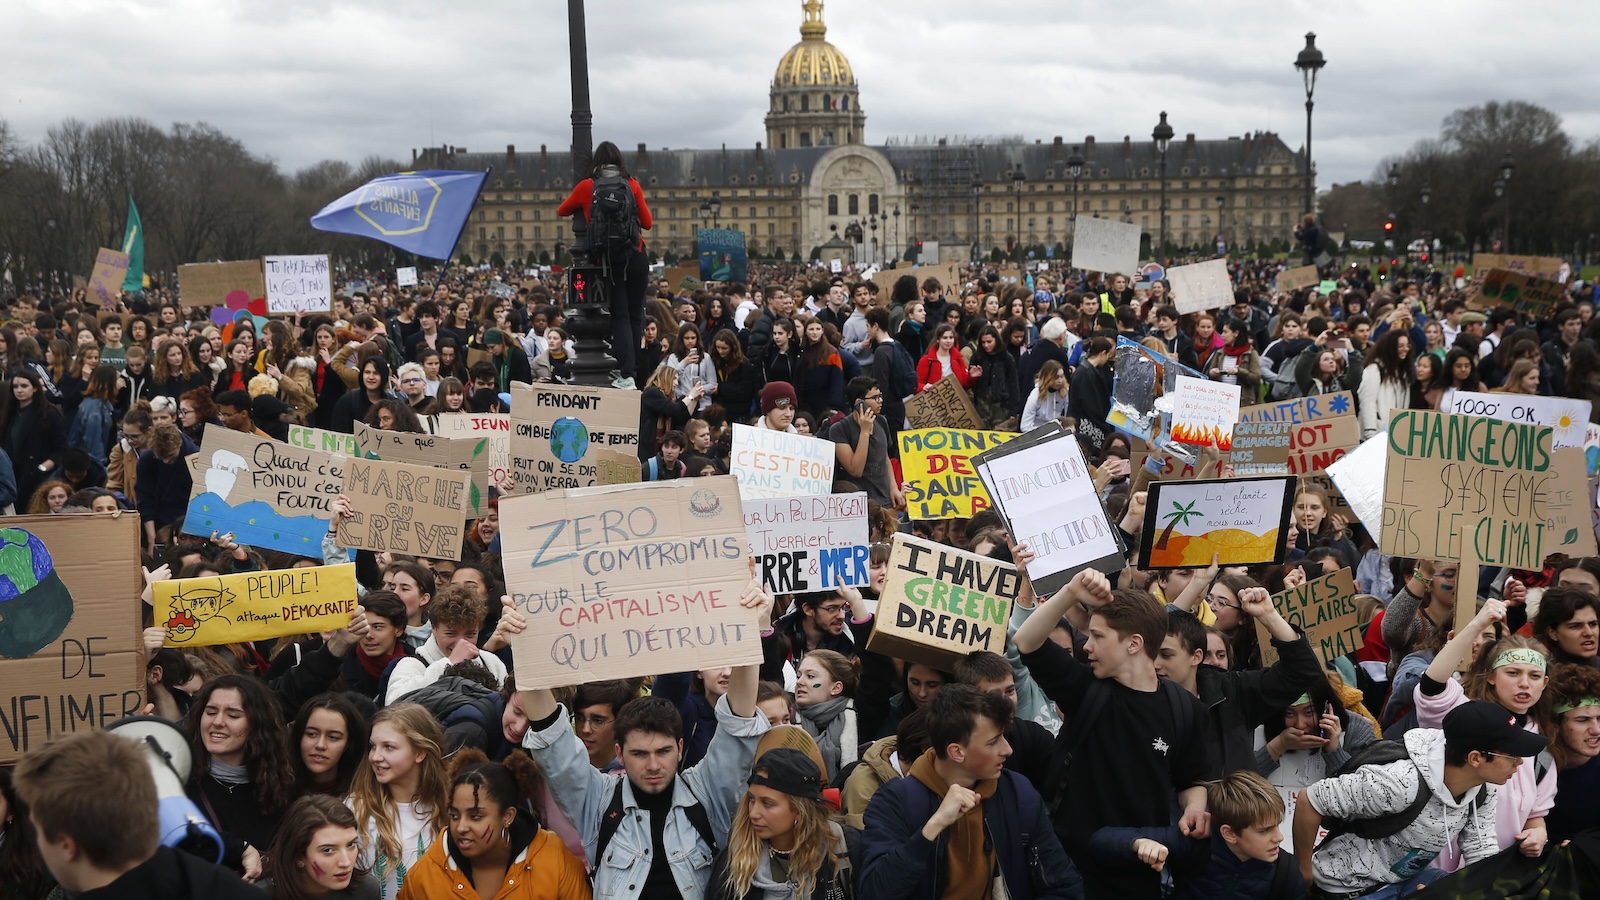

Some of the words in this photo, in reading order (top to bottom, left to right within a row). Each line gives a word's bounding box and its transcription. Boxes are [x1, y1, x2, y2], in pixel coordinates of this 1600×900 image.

[268, 278, 277, 293] LA
[299, 278, 306, 294] 1
[305, 297, 317, 311] 15
[319, 296, 328, 307] X
[537, 392, 601, 410] PENDANT
[912, 395, 931, 416] PAS
[938, 378, 965, 414] PRENEZ
[453, 419, 467, 431] LA
[1454, 399, 1500, 416] 1000°
[1511, 405, 1541, 426] OK,
[290, 427, 316, 449] CE
[516, 424, 559, 440] COMBIEN
[590, 432, 605, 444] DE
[608, 433, 639, 446] TEMPS
[734, 425, 757, 447] LA
[903, 430, 1002, 453] MOINS
[1232, 435, 1290, 448] CHANGER
[1235, 422, 1257, 435] ON
[1258, 422, 1290, 434] PEUT
[1389, 411, 1553, 472] CHANGEONS
[375, 434, 383, 449] y
[393, 437, 404, 445] a
[414, 438, 435, 451] que
[253, 442, 312, 473] Quand
[513, 457, 534, 470] PEUT
[537, 460, 554, 473] ON
[559, 462, 574, 475] SE
[737, 450, 795, 473] C'EST
[799, 459, 832, 481] BON
[926, 454, 973, 475] DE
[1231, 450, 1253, 462] NOS
[252, 470, 307, 489] FONDU
[314, 480, 341, 495] c'es
[349, 462, 464, 511] MARCHE
[513, 471, 538, 486] QU'ON
[544, 476, 579, 489] VERRA
[733, 467, 781, 489] DANS
[792, 477, 831, 494] MON
[909, 478, 980, 503] SAUF
[999, 455, 1087, 502] INACTION
[1384, 456, 1422, 508] LE
[277, 491, 332, 512] FOUTU
[1205, 489, 1222, 501] La
[1233, 486, 1268, 501] planète
[1327, 495, 1347, 507] TE
[385, 502, 413, 520] OU
[743, 512, 763, 526] UR
[765, 503, 785, 523] Un
[789, 498, 807, 523] Peu
[812, 494, 868, 522] D'ARGENT
[920, 498, 960, 519] LA
[1206, 519, 1229, 527] nous
[1382, 507, 1423, 556] PAS
[1435, 510, 1463, 560] LE
[526, 506, 658, 569] ZERO
[583, 536, 741, 577] COMPROMIS
[755, 550, 808, 593] RRE
[808, 558, 819, 576] &
[819, 545, 869, 588] MER
[897, 541, 931, 576] I
[935, 550, 1021, 599] HAVE
[512, 587, 575, 614] POUR
[580, 581, 614, 603] LE
[903, 576, 1008, 625] GREEN
[236, 611, 281, 627] attaque
[282, 599, 355, 622] DÉMOCRATIE
[1288, 593, 1357, 629] OLAIRES
[895, 602, 992, 651] DREAM
[550, 632, 608, 670] QUI
[622, 622, 746, 659] DÉTRUIT
[1320, 625, 1359, 662] MAT
[62, 636, 108, 680] DE
[0, 690, 142, 752] NFUMER
